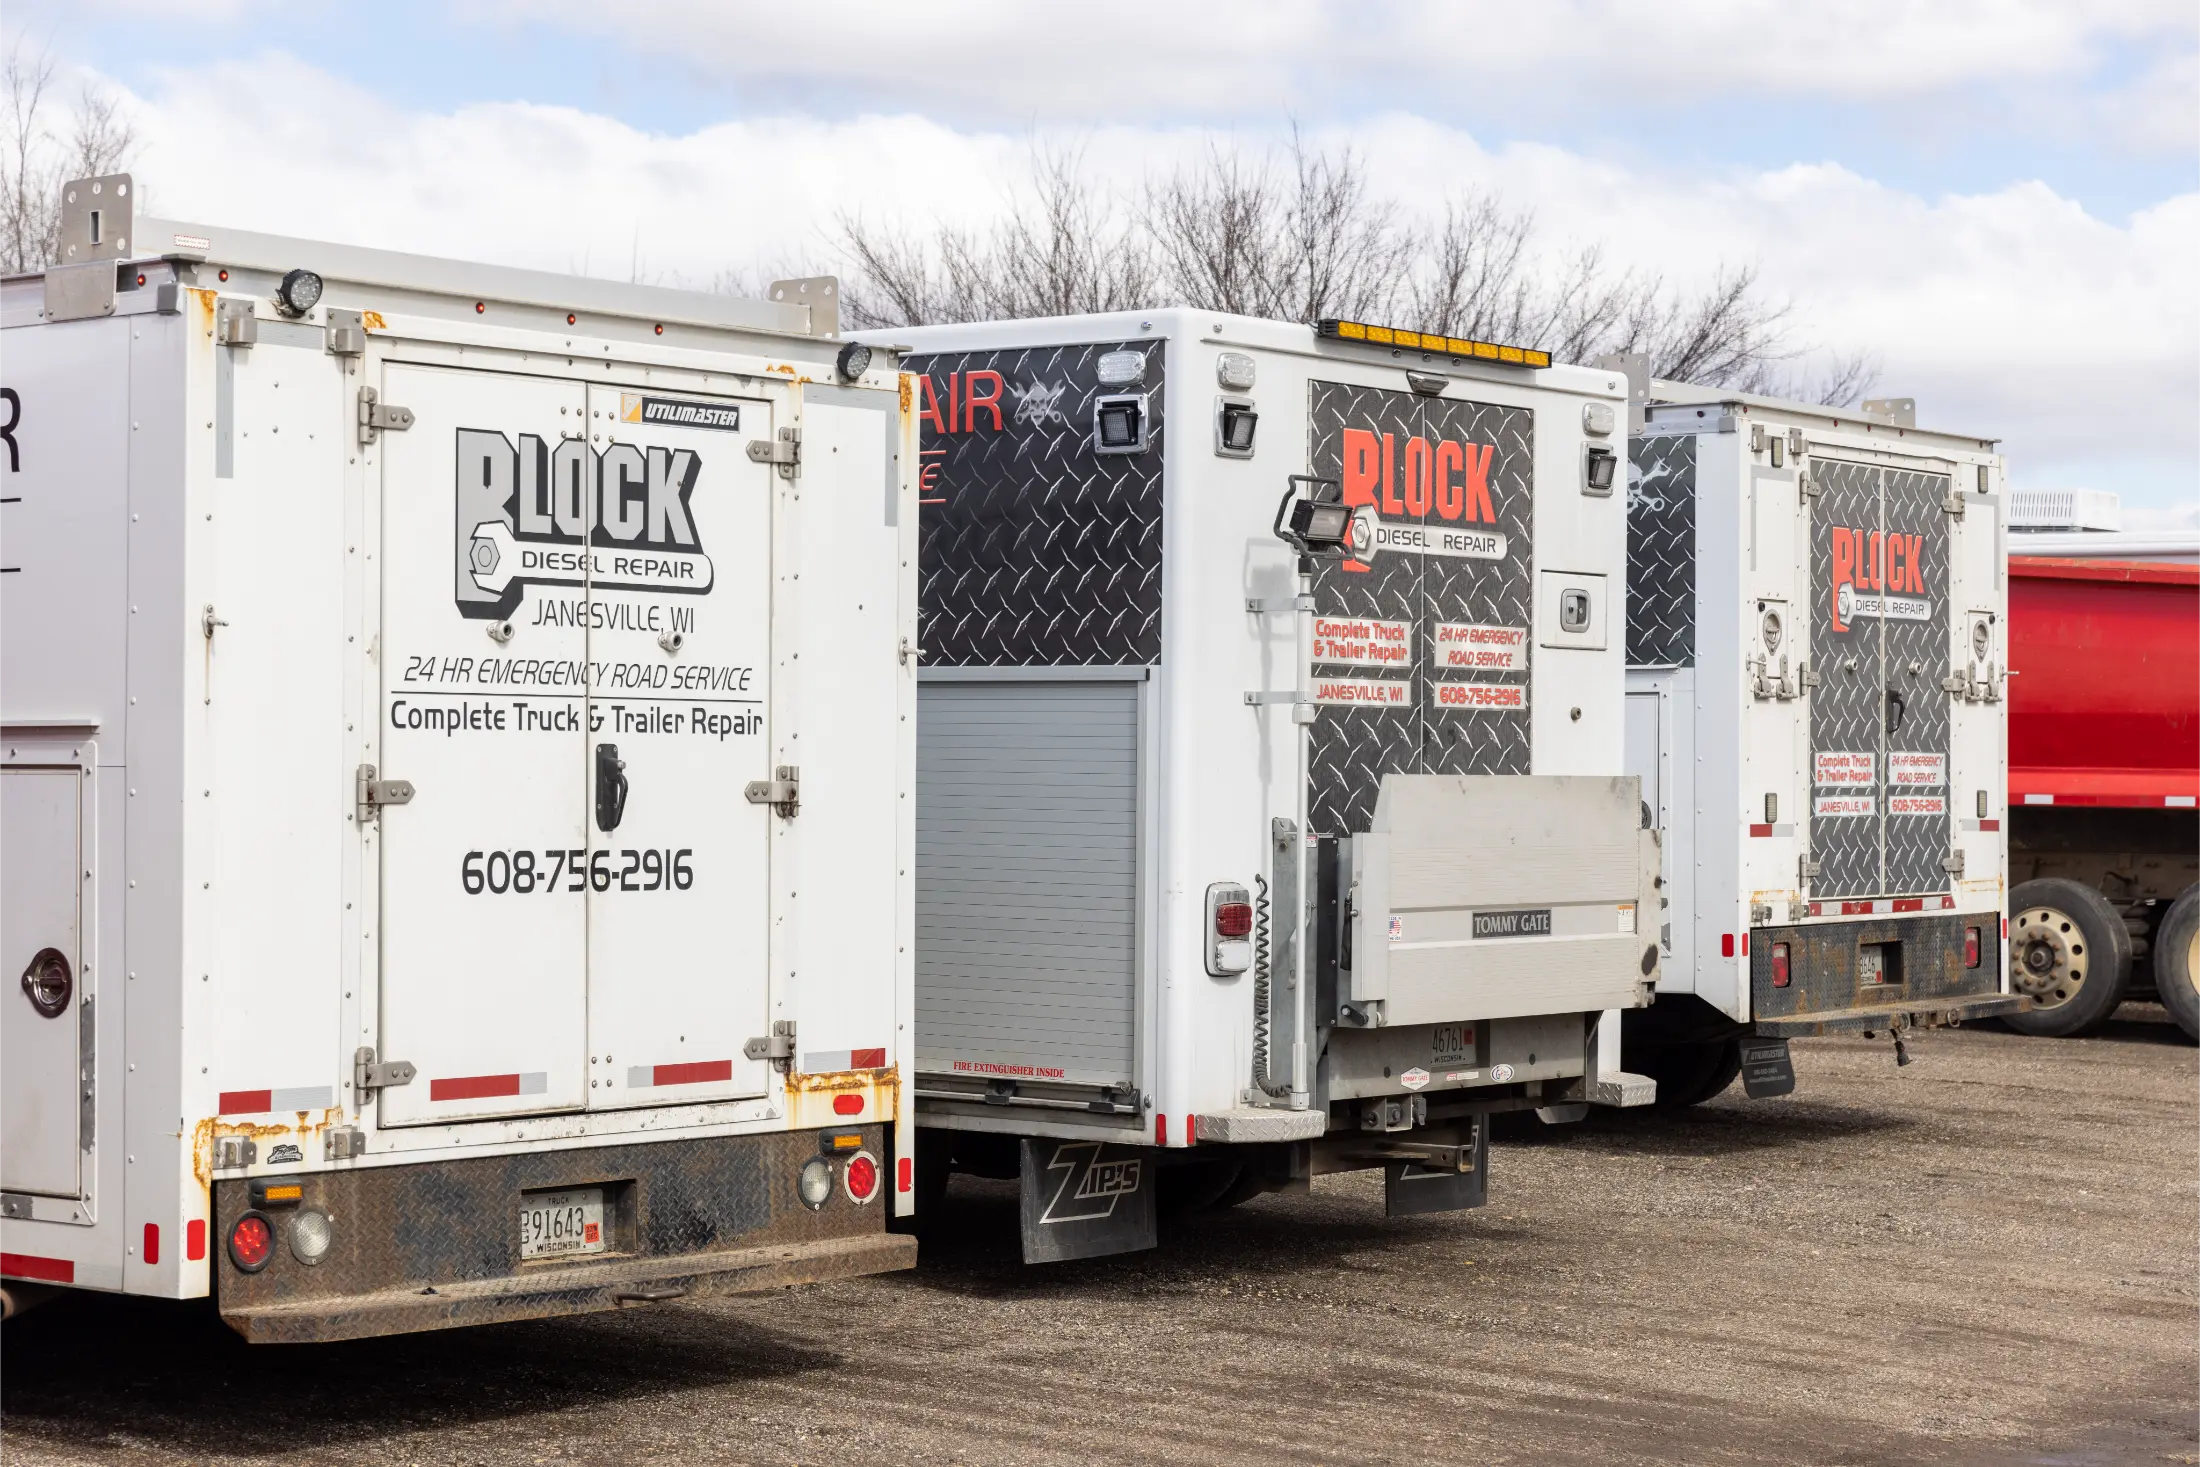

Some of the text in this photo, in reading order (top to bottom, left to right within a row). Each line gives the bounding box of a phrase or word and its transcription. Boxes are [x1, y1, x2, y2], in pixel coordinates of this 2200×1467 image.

[645, 403, 738, 427] UTILIMASTER
[1343, 428, 1497, 573] BLOCK
[456, 427, 703, 620] BLOCK
[1376, 528, 1497, 553] DIESEL REPAIR
[522, 550, 695, 580] DIESEL REPAIR
[1833, 527, 1925, 632] BLOCK
[532, 599, 694, 634] JANESVILLE, WI
[1856, 600, 1925, 615] DIESEL REPAIR
[1315, 620, 1405, 641] Complete Truck
[1439, 627, 1524, 646] 24 HR EMERGENCY
[1313, 640, 1408, 664] & Trailer Repair
[1447, 651, 1513, 667] ROAD SERVICE
[404, 657, 752, 692] 24 HR EMERGENCY ROAD SERVICE
[1316, 684, 1403, 703] JANESVILLE, WI
[1440, 687, 1521, 705] 608-756-2916
[391, 700, 763, 741] Complete Truck & Trailer Repair
[1818, 755, 1871, 770] Complete Truck
[1892, 755, 1900, 767] 24
[1909, 756, 1944, 768] EMERGENCY
[1817, 770, 1873, 784] & Trailer Repair
[1897, 772, 1937, 784] ROAD SERVICE
[1819, 801, 1870, 813] JANESVILLE, WI
[1892, 799, 1943, 813] 608-756-2916
[462, 848, 694, 894] 608-756-2916
[1475, 914, 1550, 934] TOMMY GATE
[1432, 1028, 1464, 1052] 46761
[1434, 1055, 1462, 1063] WISCONSIN
[953, 1061, 1065, 1079] FIRE EXTINGUISHER INSIDE
[1039, 1141, 1142, 1224] ZIP'S
[548, 1197, 570, 1205] TRUCK
[537, 1241, 581, 1252] WISCONSIN
